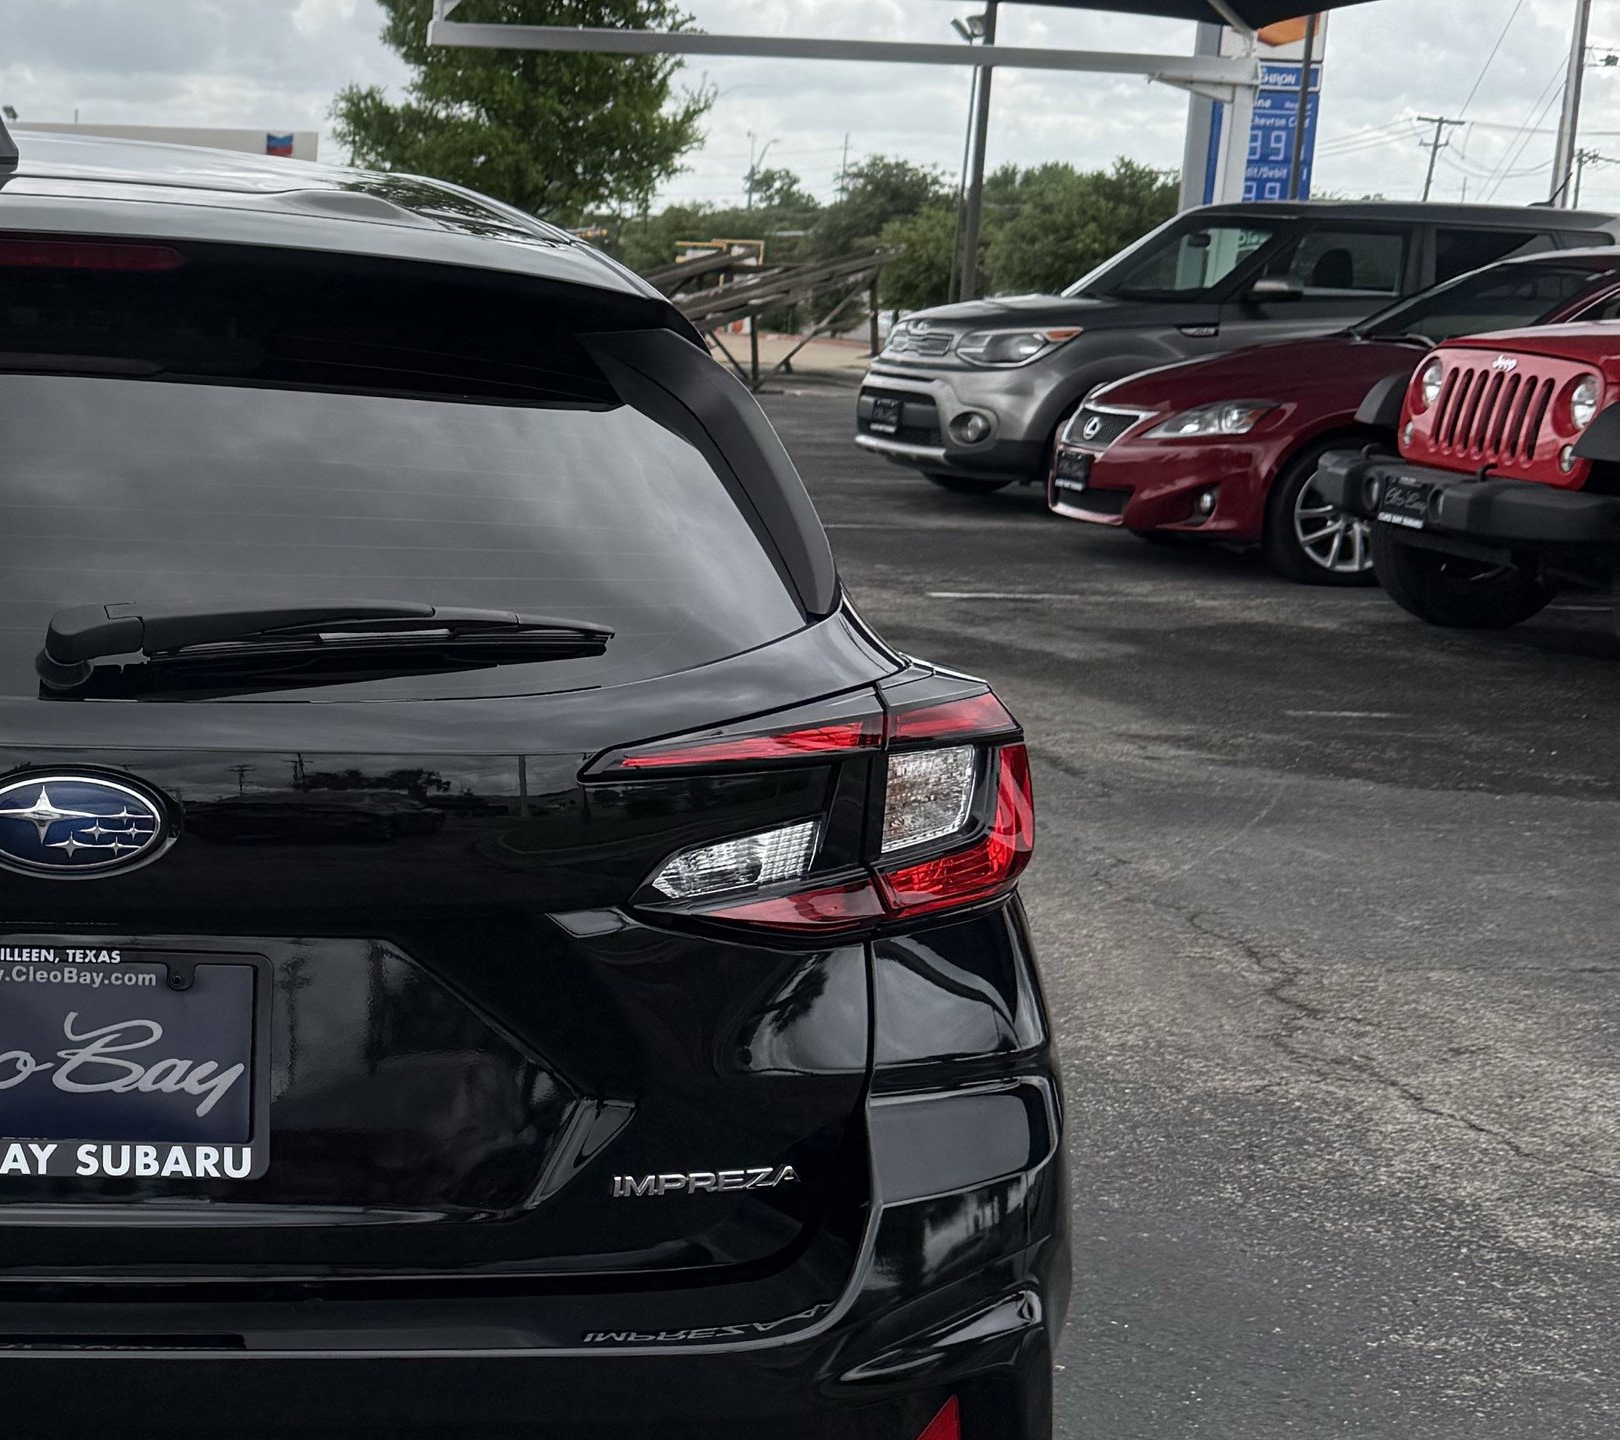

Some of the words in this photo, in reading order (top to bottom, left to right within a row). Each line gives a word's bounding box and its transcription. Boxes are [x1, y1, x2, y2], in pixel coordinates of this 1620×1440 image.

[66, 949, 121, 963] TEXAS
[51, 1012, 245, 1117] Bay
[76, 1145, 251, 1178] SUBARU
[612, 1165, 801, 1197] IMPREZA
